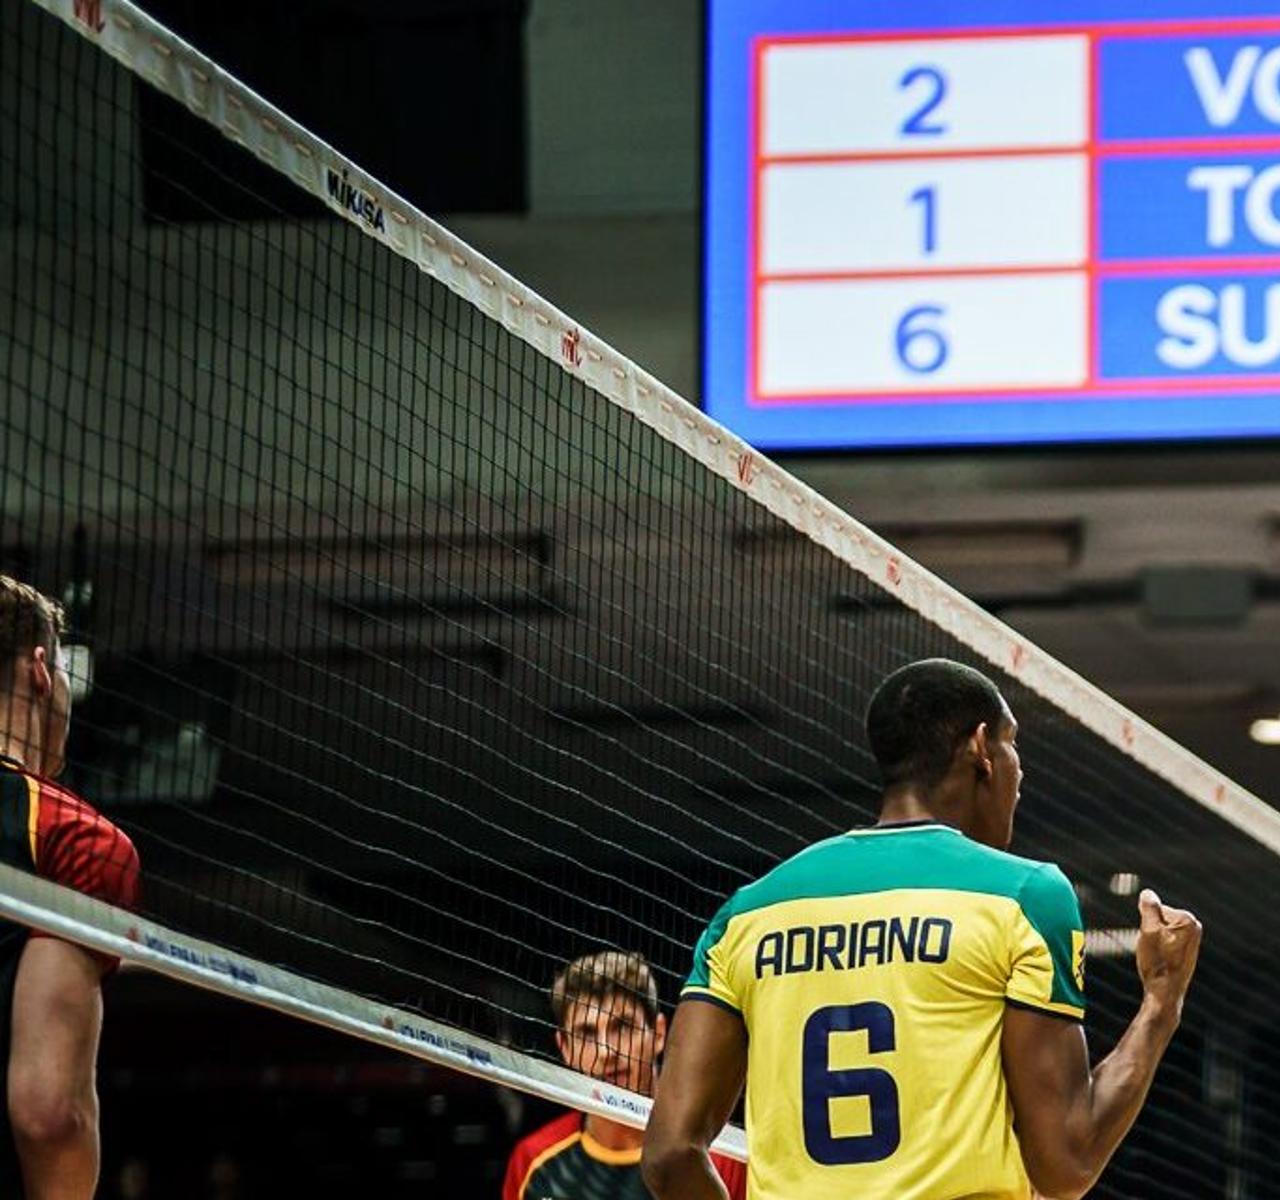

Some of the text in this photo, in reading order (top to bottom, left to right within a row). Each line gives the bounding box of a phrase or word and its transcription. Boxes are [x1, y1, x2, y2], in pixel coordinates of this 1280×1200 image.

[897, 65, 948, 136] 2
[327, 167, 386, 234] MIKASA
[906, 185, 939, 255] 1
[894, 303, 950, 374] 6
[755, 916, 953, 979] ADRIANO
[801, 1001, 901, 1166] 6
